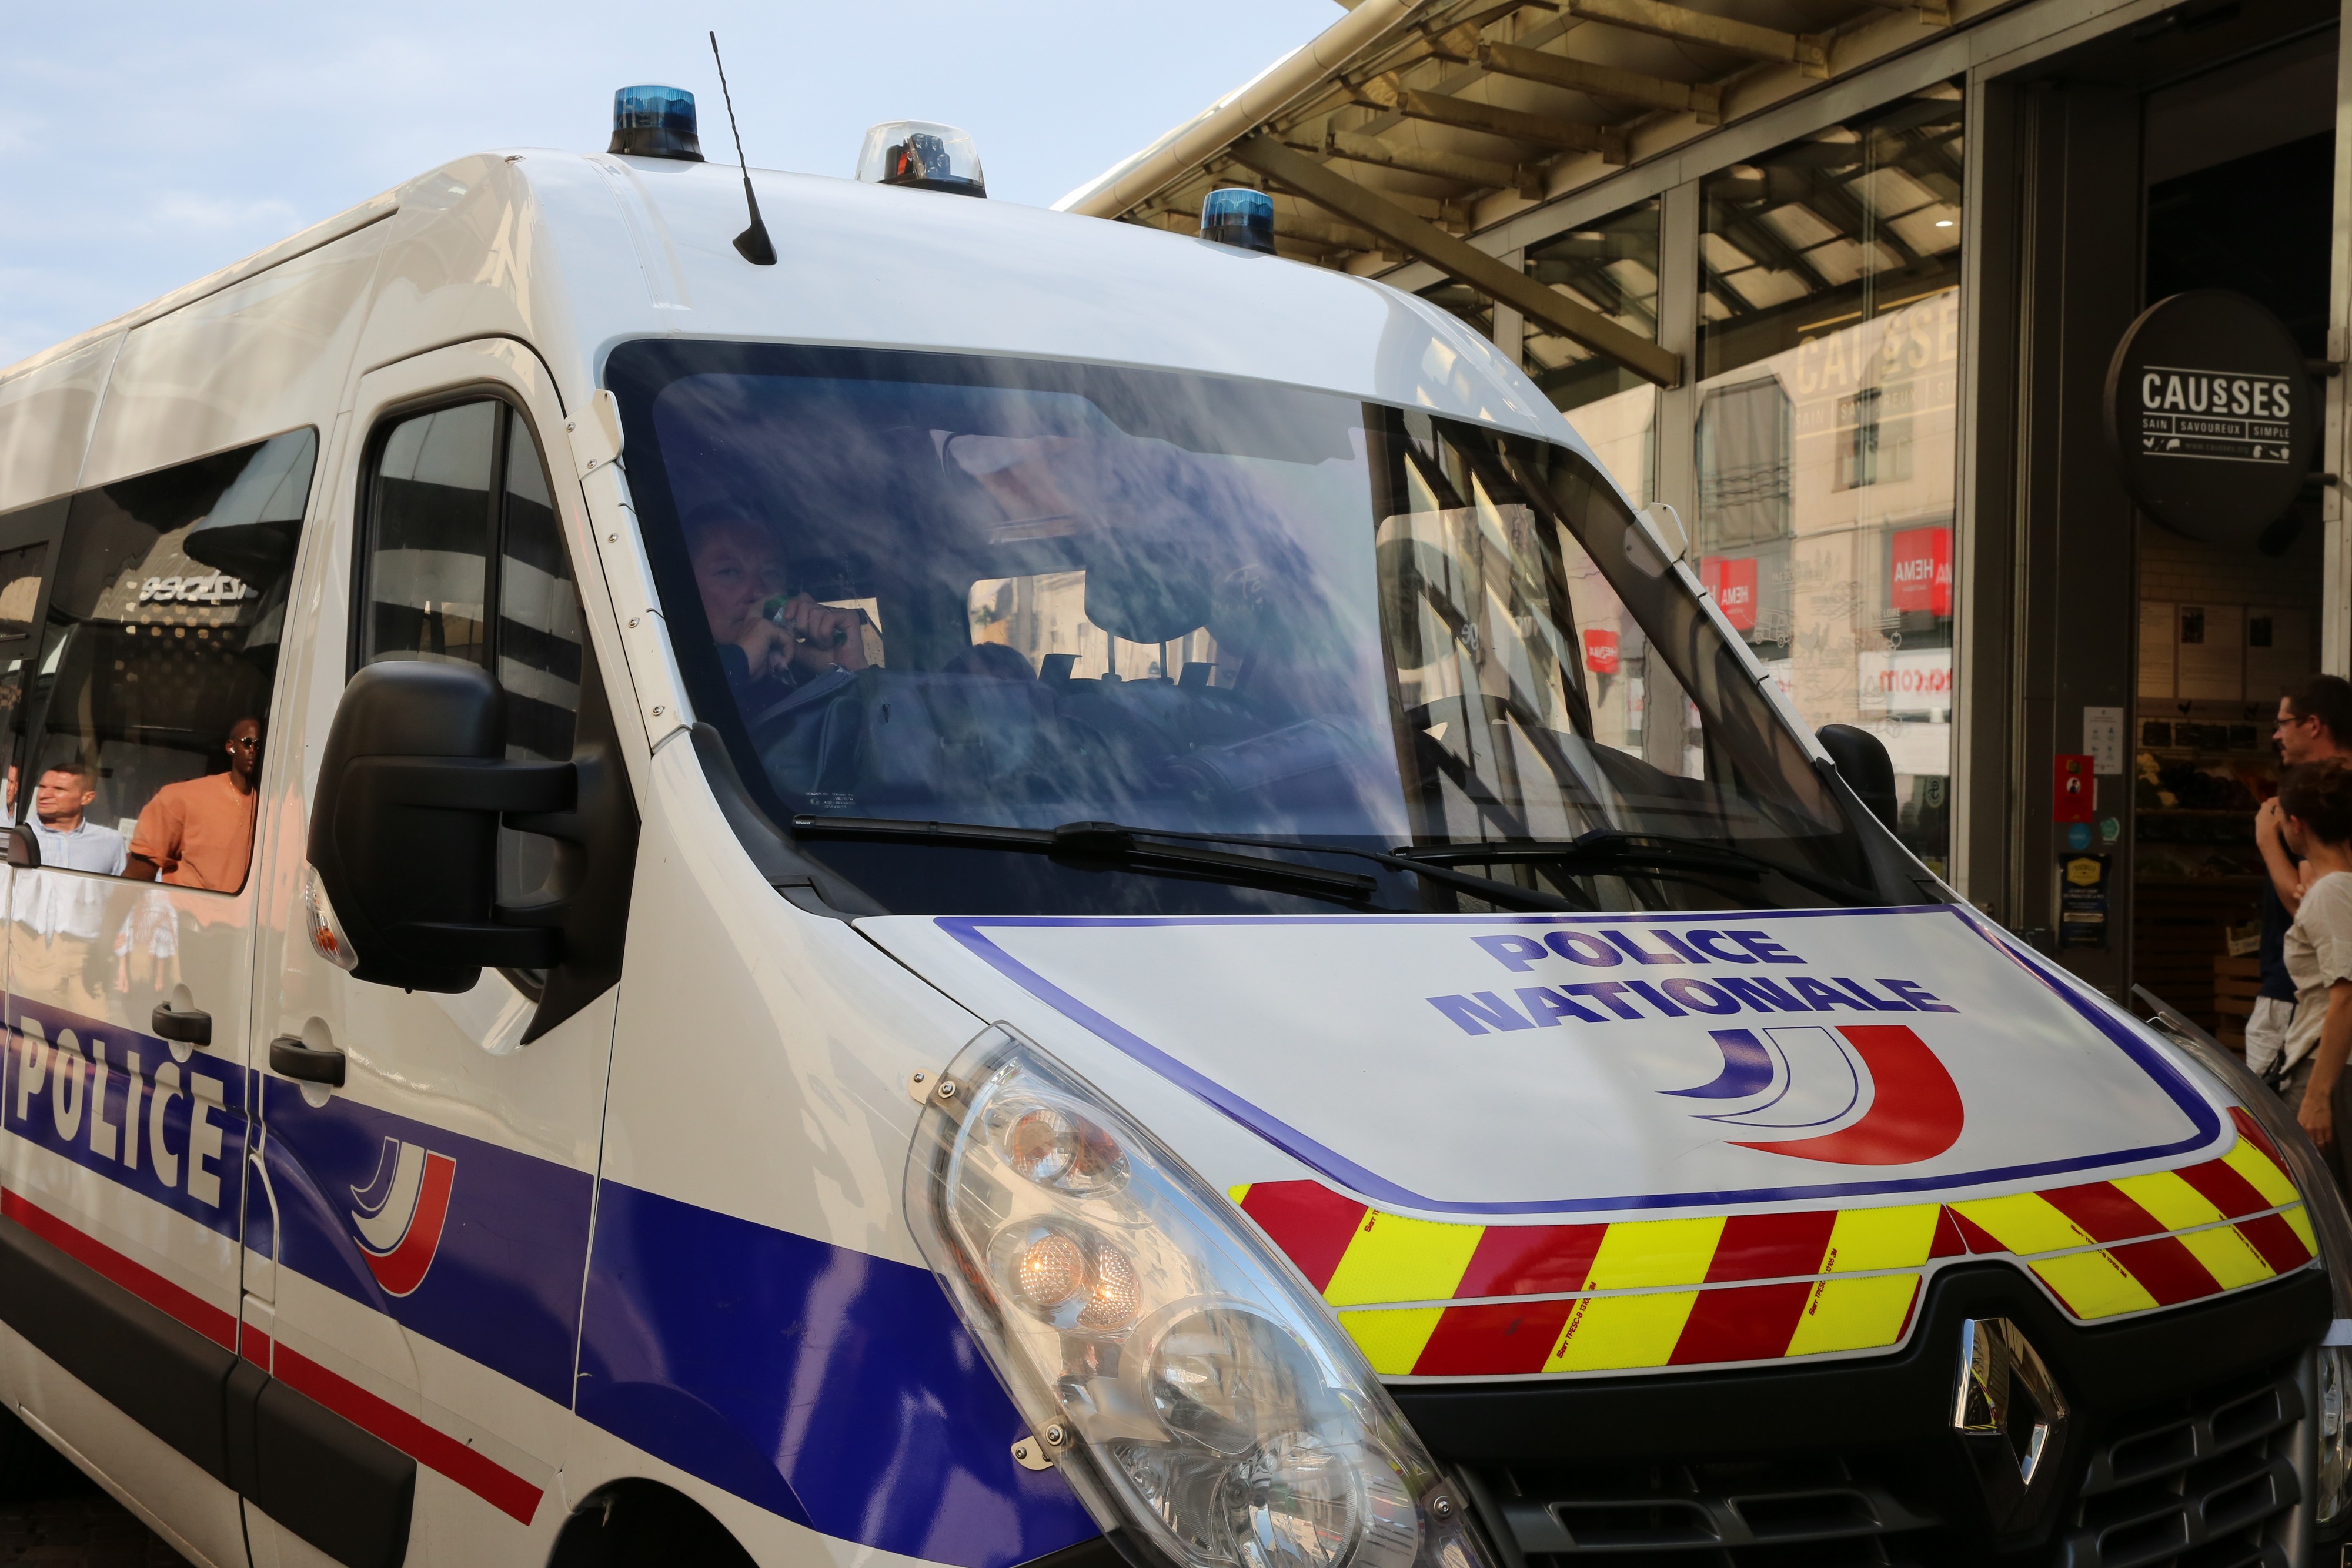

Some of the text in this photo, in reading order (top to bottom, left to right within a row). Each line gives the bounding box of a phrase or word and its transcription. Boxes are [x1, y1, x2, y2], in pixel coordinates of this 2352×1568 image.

[2143, 373, 2290, 417] CAUSSES
[2143, 418, 2290, 439] SAIN SAVOUREUX SIMPLE
[1470, 929, 1806, 973] POLICE
[1426, 976, 1960, 1035] NATIONALE
[17, 1015, 226, 1209] POLICE
[1826, 1257, 1835, 1273] 13105
[1565, 1312, 1583, 1339] TPESC-B
